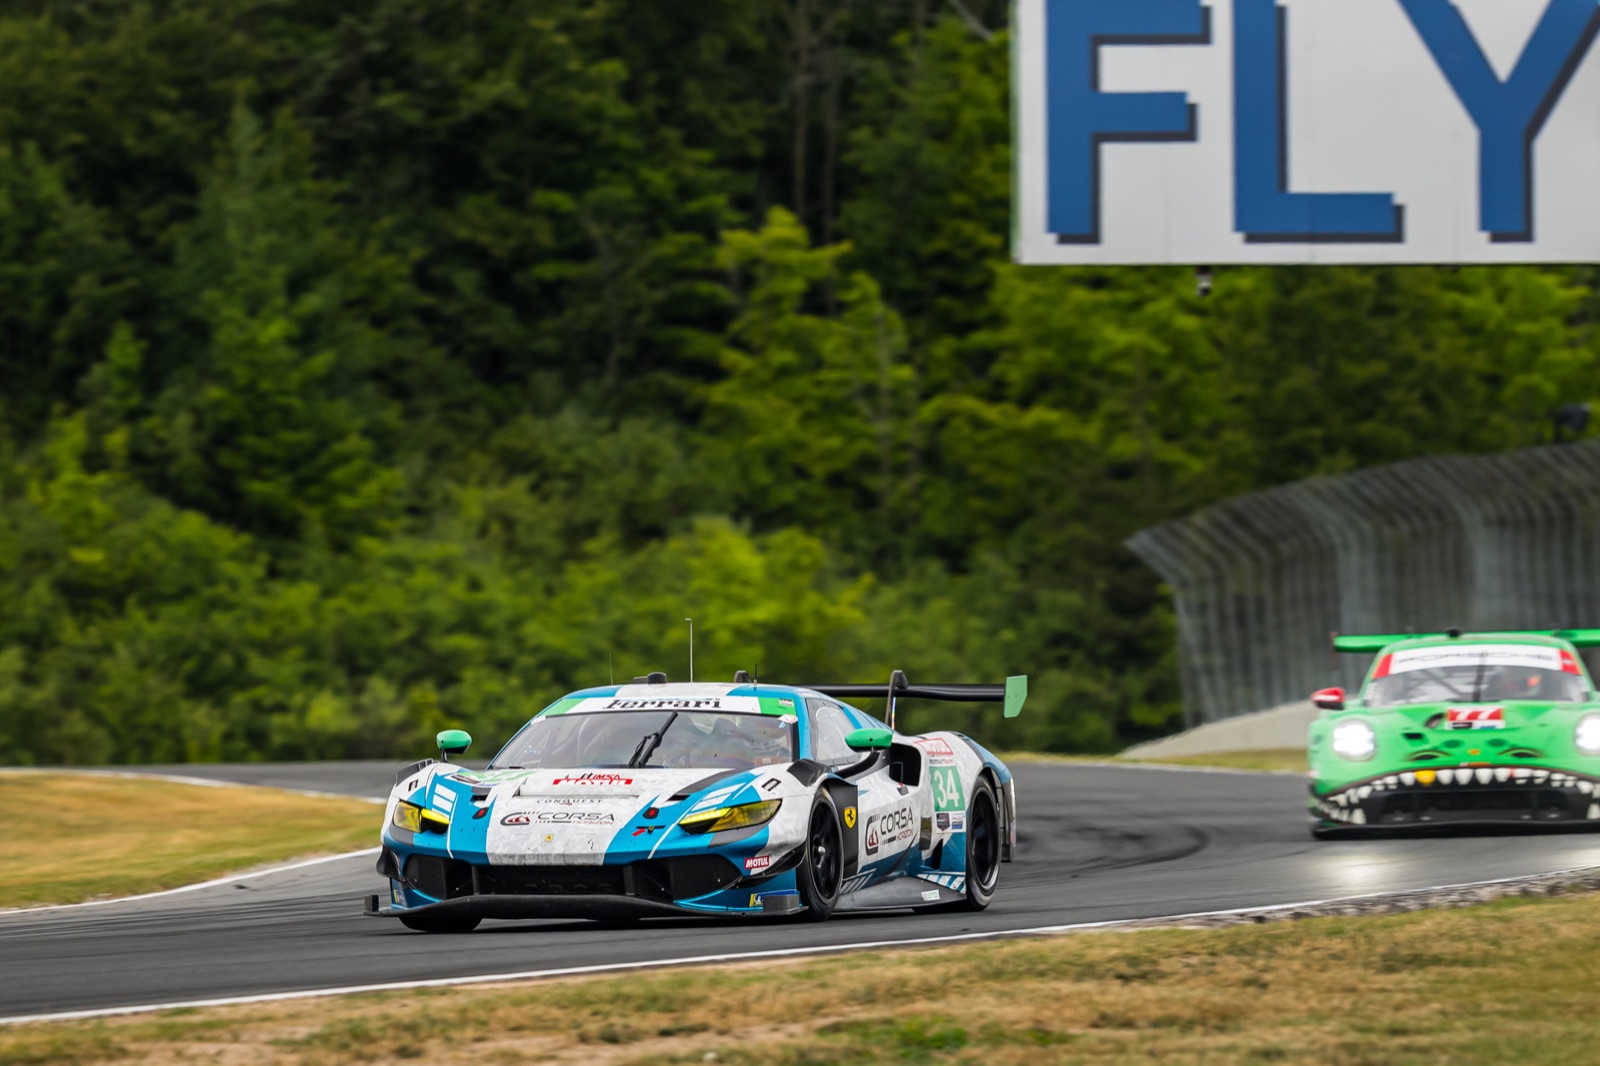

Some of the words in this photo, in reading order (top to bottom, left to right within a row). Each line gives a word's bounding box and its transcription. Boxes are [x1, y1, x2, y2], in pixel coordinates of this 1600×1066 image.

[1046, 0, 1600, 244] FLY
[602, 698, 721, 709] Ferrari
[1452, 706, 1499, 721] 77
[934, 769, 960, 808] 34
[537, 812, 615, 821] CORSA
[880, 806, 914, 836] CORSA
[745, 857, 769, 868] MOTUL
